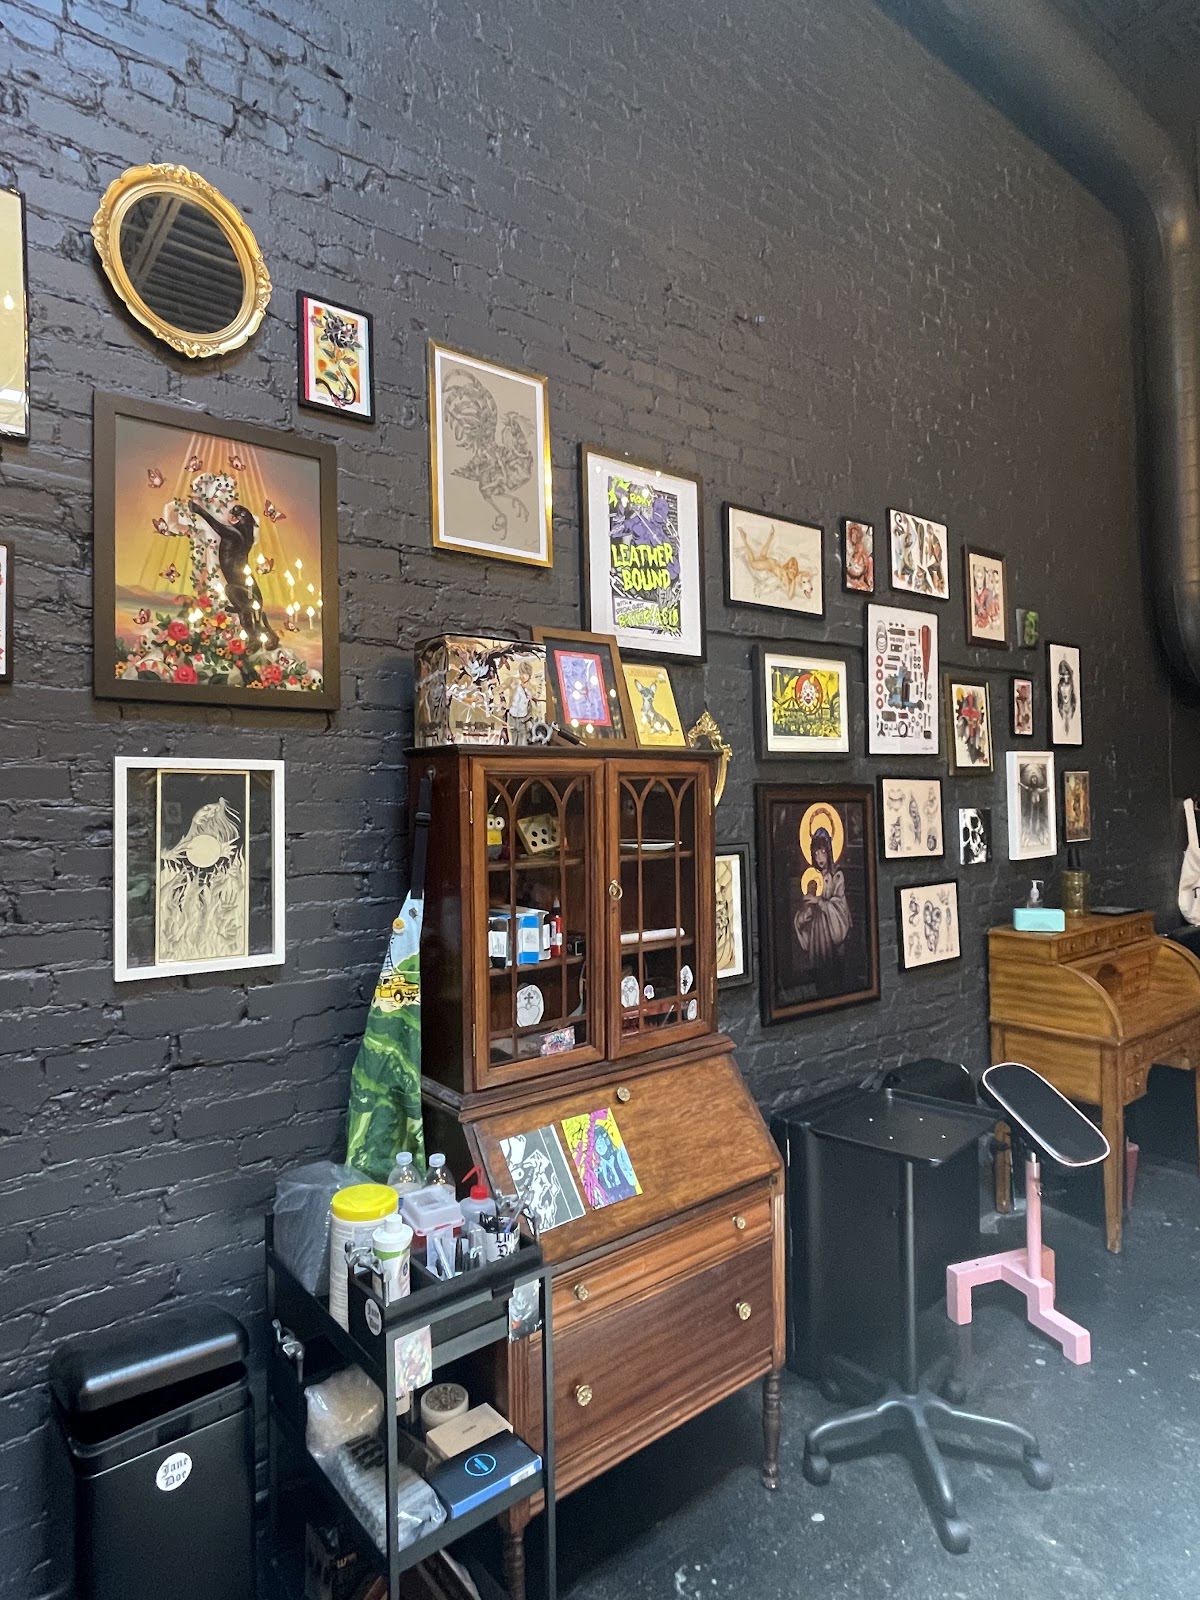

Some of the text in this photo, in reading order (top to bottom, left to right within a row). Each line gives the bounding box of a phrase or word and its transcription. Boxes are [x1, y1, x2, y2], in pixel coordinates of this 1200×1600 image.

[611, 542, 674, 568] LEATHER
[621, 567, 671, 592] BOUND
[160, 1457, 188, 1479] Jane
